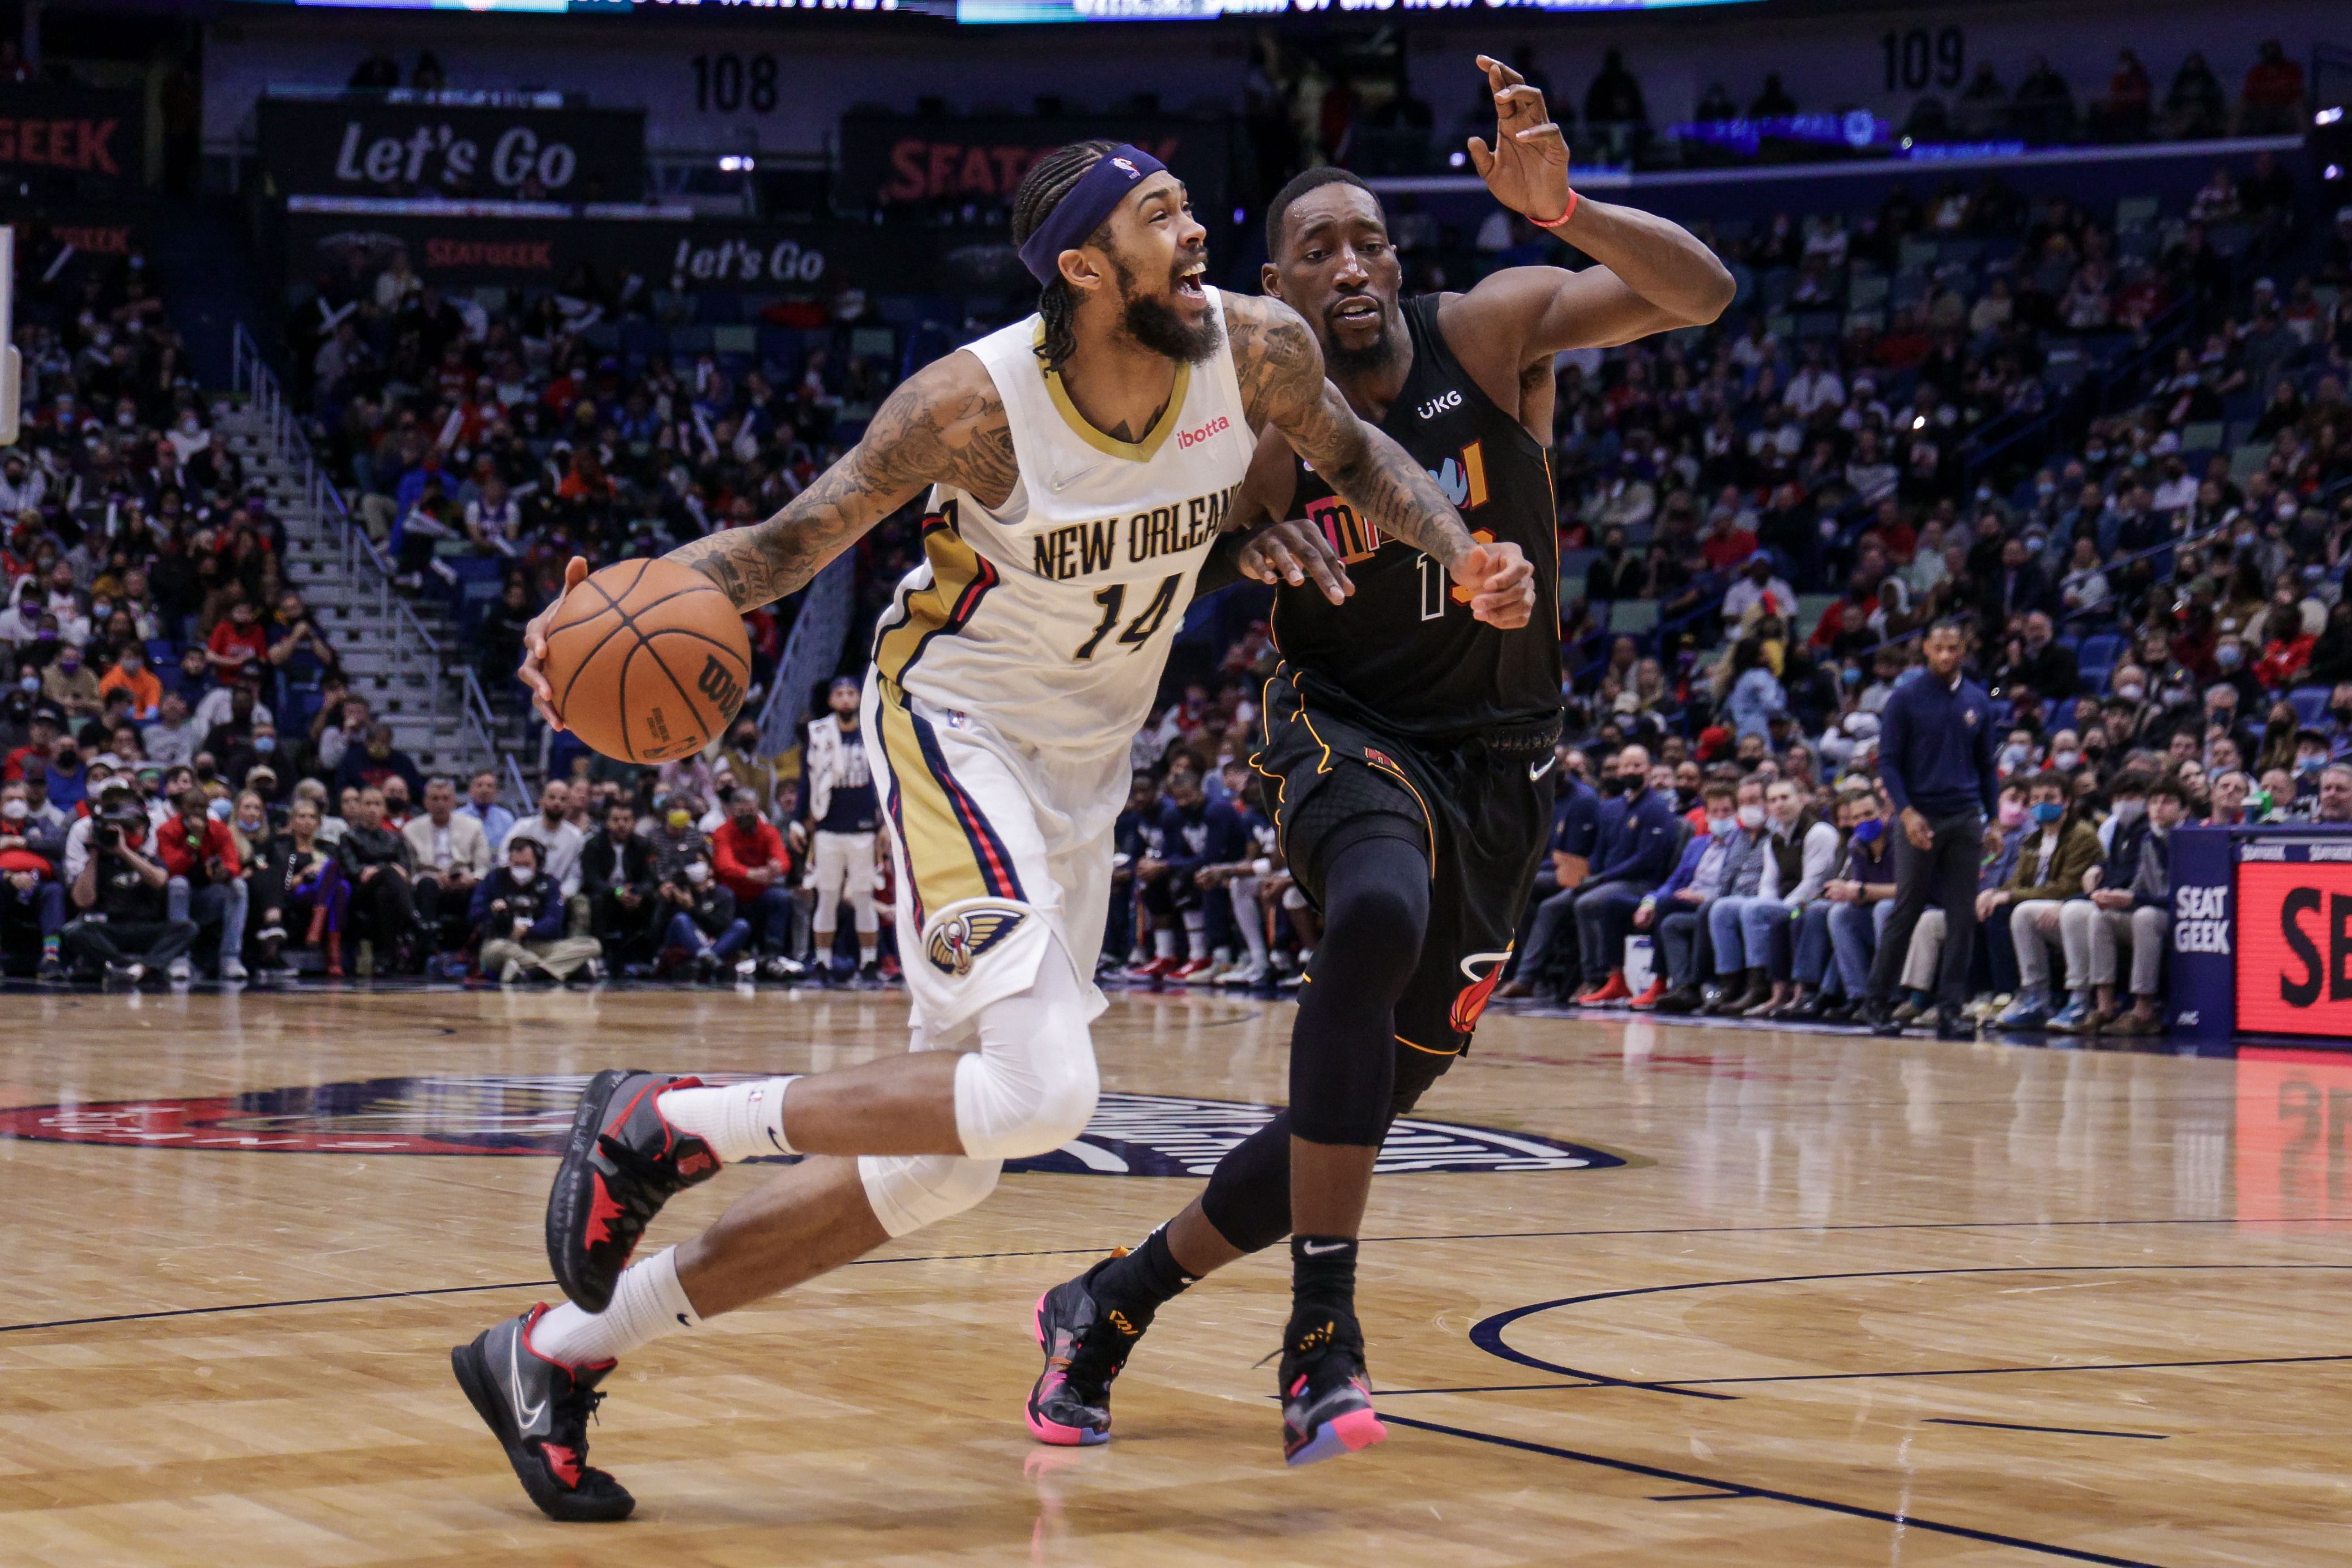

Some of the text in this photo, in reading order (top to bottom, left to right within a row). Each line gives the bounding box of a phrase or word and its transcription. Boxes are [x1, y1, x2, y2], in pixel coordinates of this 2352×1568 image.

[691, 53, 779, 113] 108
[1884, 24, 1964, 91] 109
[336, 121, 578, 190] Let's Go
[769, 240, 826, 282] Go
[1177, 415, 1230, 450] ibotta
[1034, 517, 1119, 581] NEW
[1074, 571, 1186, 661] 14
[2176, 885, 2229, 920] SEAT
[2175, 919, 2231, 955] GEEK
